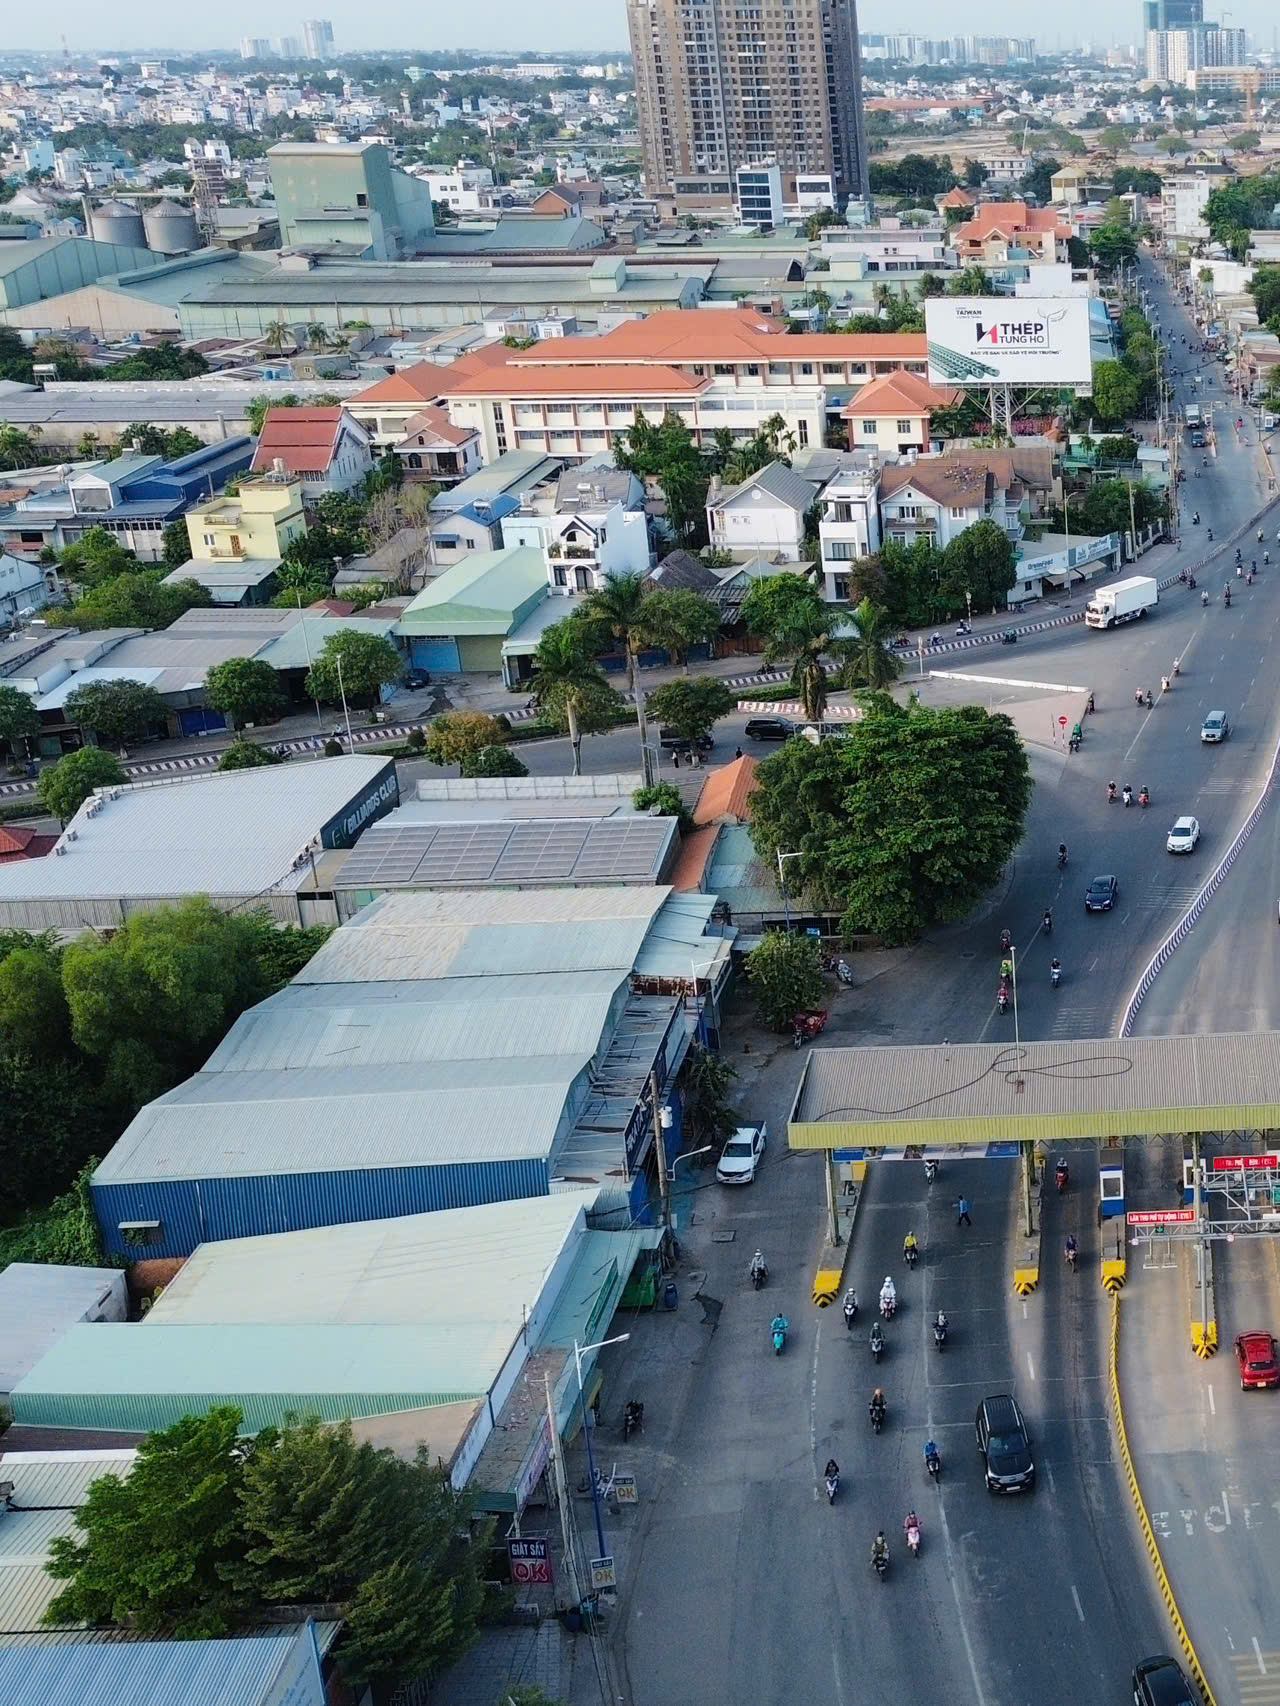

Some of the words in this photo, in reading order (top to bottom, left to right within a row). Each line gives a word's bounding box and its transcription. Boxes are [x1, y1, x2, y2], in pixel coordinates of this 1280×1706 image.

[1000, 320, 1044, 335] THÉP
[999, 336, 1027, 344] TUNG
[1029, 335, 1044, 343] HO
[347, 792, 380, 835] BILLIARDS
[380, 775, 396, 800] CLUB
[618, 1487, 634, 1497] OK
[515, 1562, 548, 1582] OK
[595, 1570, 613, 1582] OK
